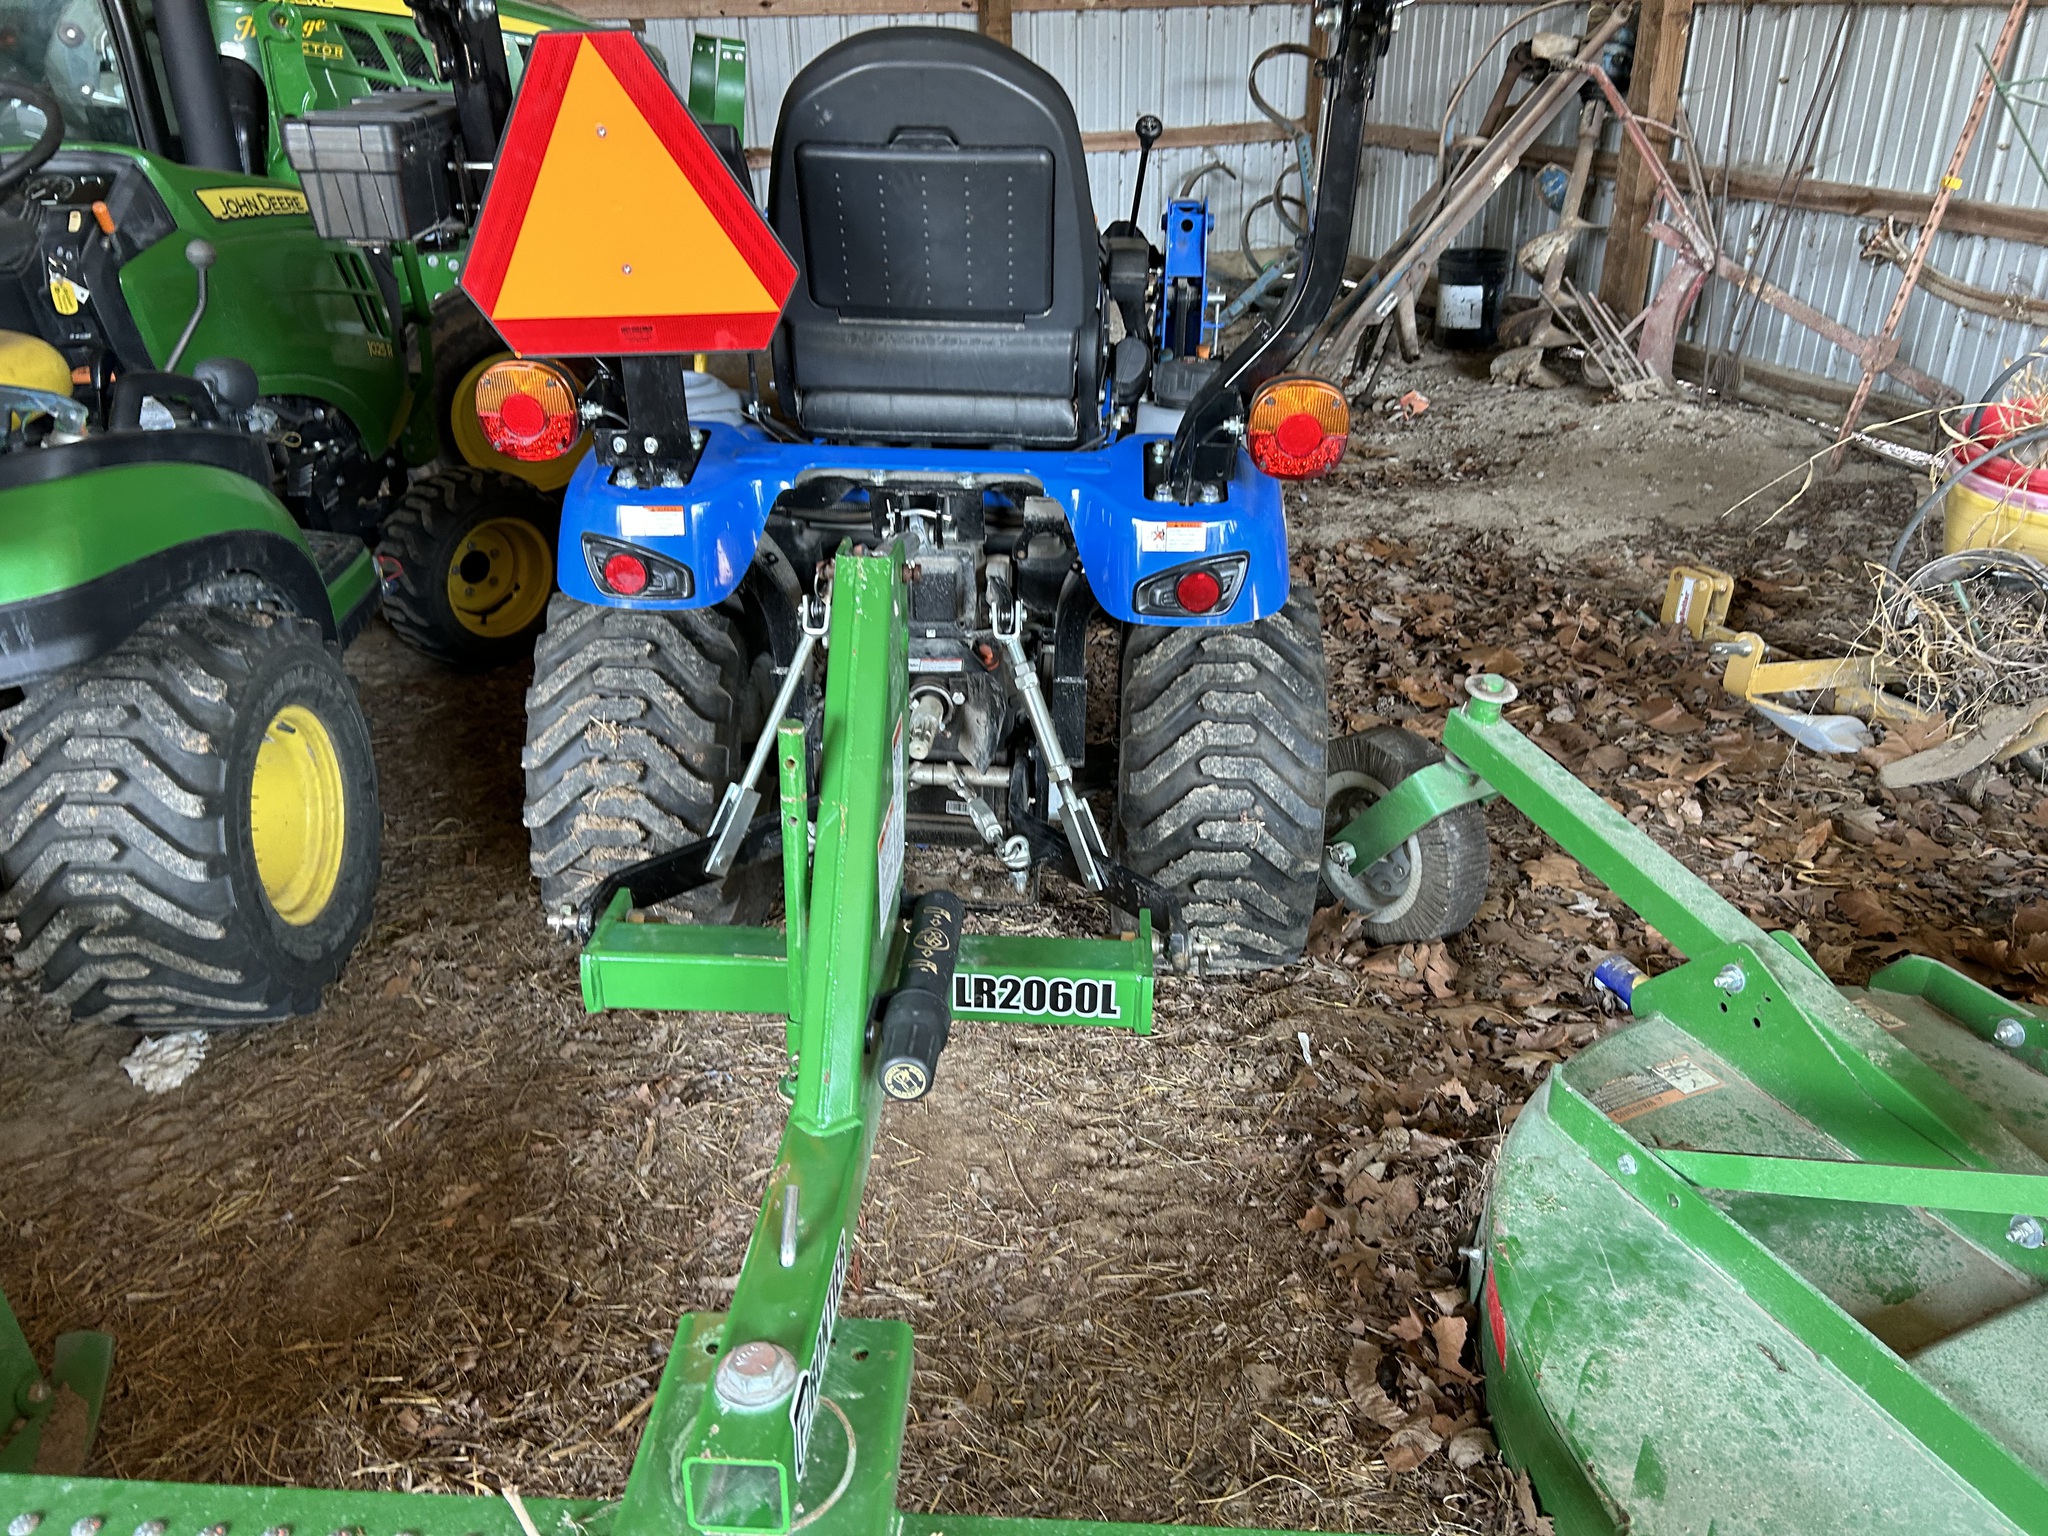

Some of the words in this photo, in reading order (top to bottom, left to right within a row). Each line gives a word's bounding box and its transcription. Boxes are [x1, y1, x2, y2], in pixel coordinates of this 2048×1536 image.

[219, 196, 259, 216] JOHN
[257, 193, 304, 212] DEERE
[955, 976, 1117, 1015] LR2060L
